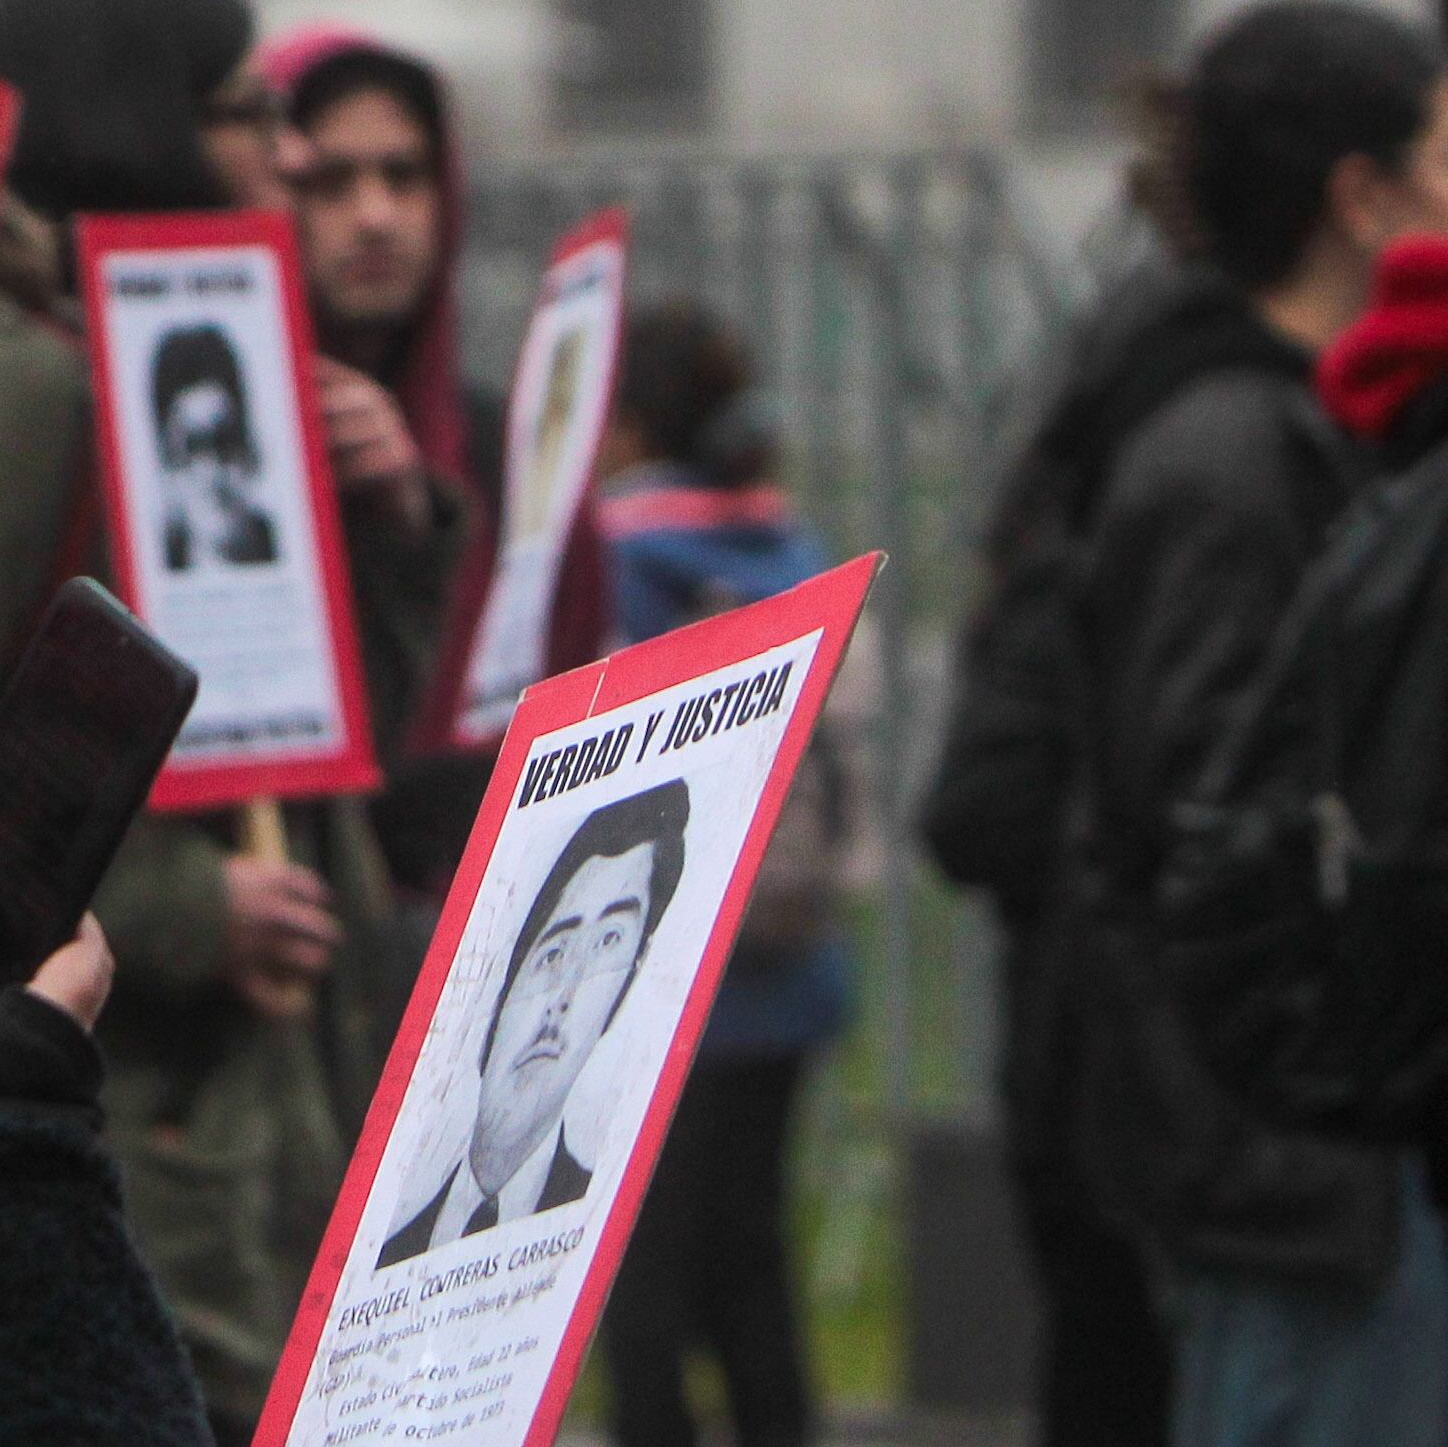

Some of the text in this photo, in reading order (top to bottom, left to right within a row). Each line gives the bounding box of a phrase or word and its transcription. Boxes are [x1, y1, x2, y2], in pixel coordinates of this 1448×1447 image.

[517, 660, 794, 809] VERDAD Y JUSTICIA
[338, 1226, 586, 1332] EXEQUIEL CONTRERAS CARRASCO
